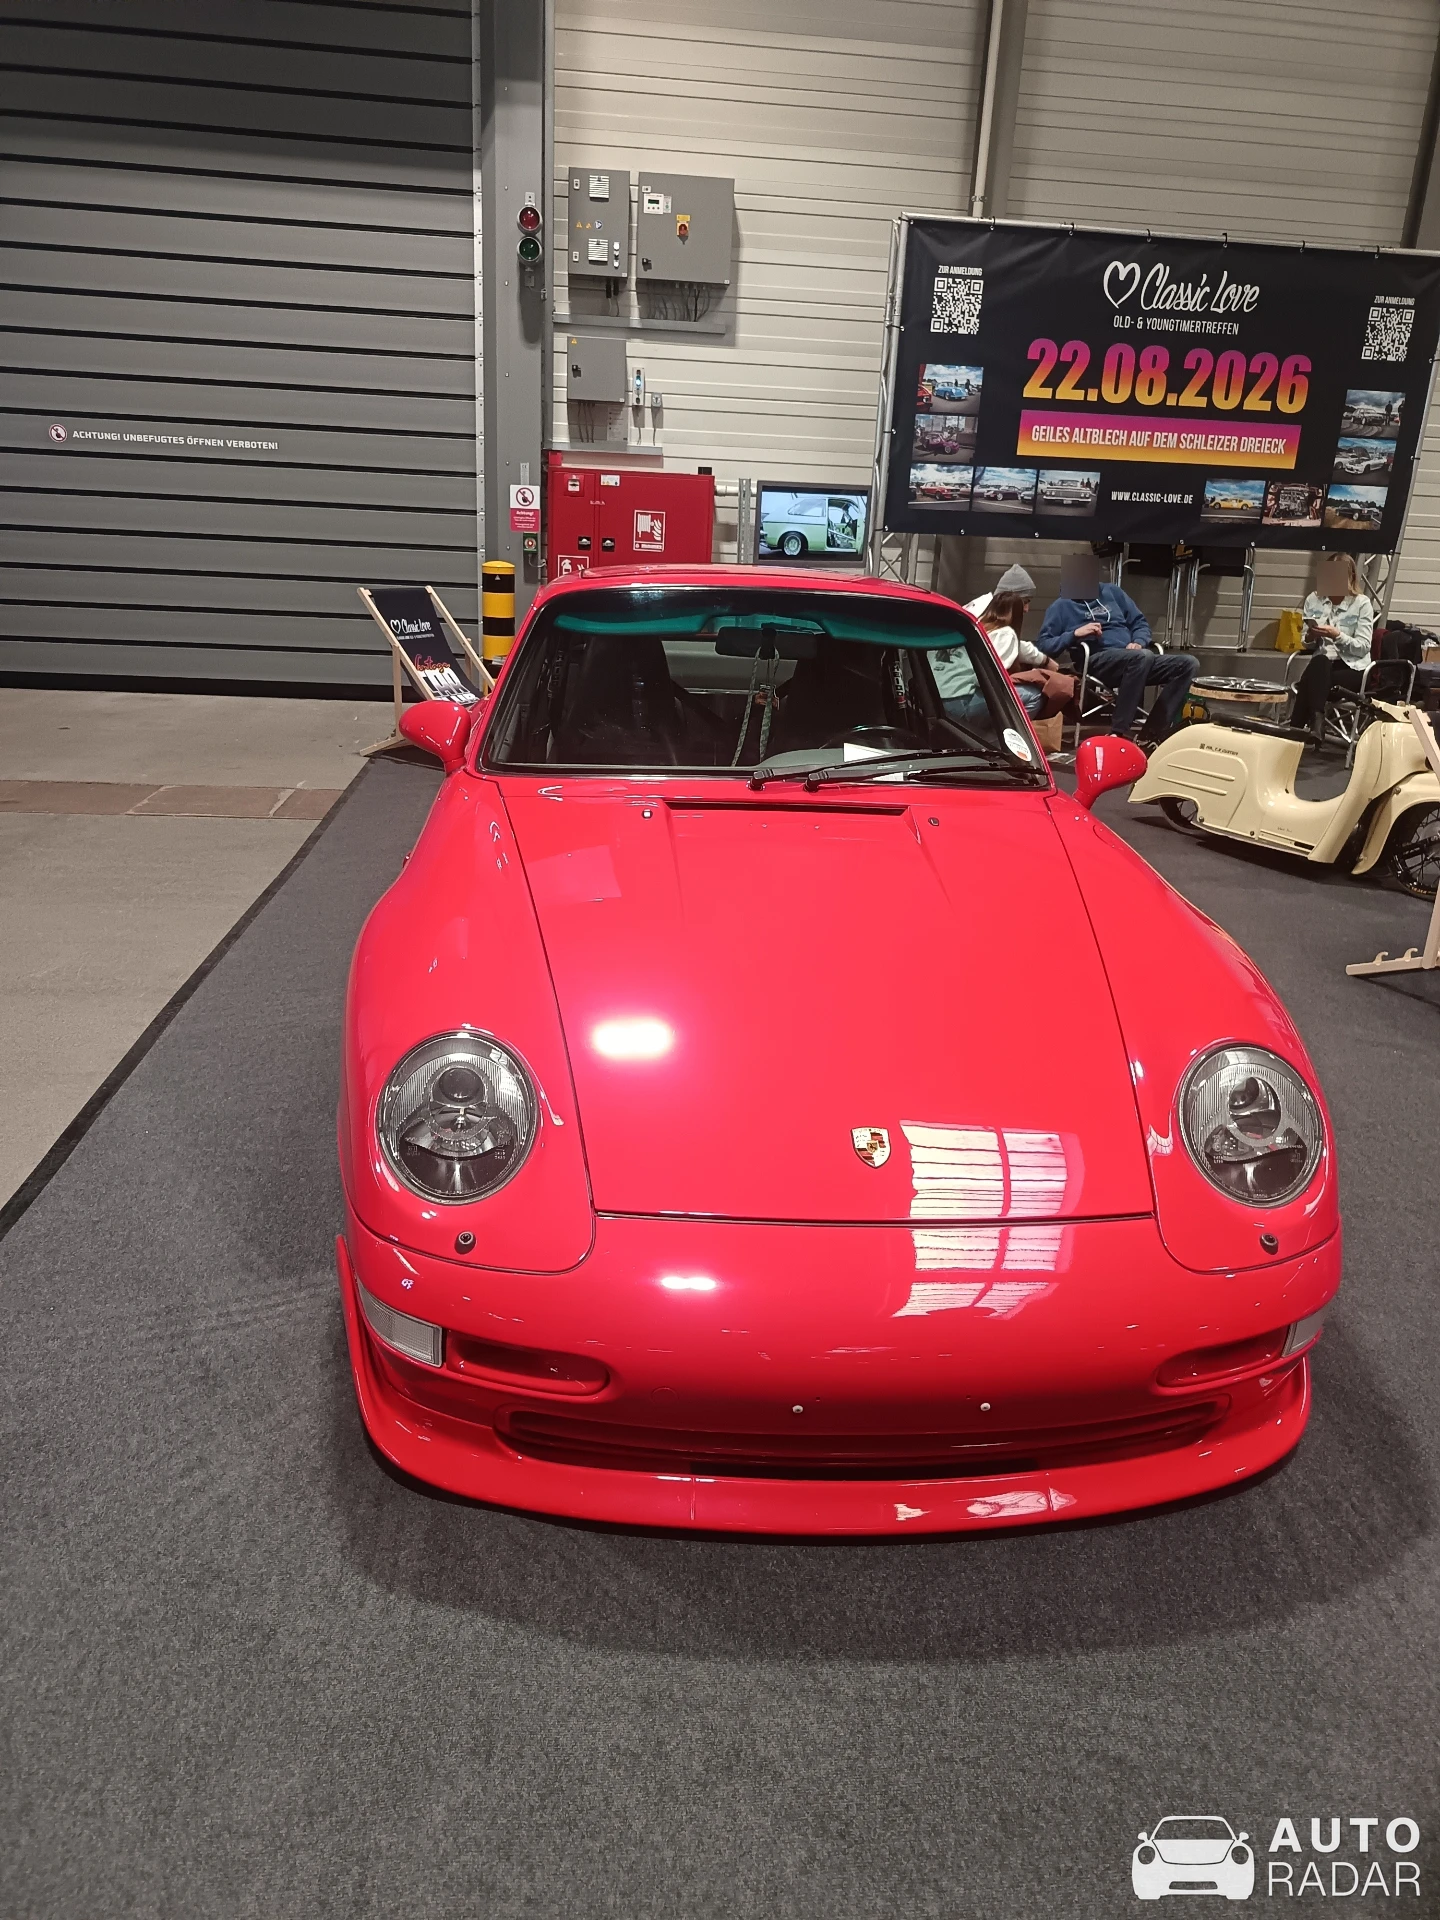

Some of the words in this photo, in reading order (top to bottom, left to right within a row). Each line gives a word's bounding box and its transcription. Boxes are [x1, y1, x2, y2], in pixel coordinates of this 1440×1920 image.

[938, 265, 949, 274] ZUR
[950, 266, 983, 276] ANMELDUNG
[1141, 262, 1211, 311] Classic
[1210, 270, 1260, 313] Love
[1374, 295, 1385, 304] ZUR
[1385, 296, 1415, 306] ANMELDUNG
[1113, 315, 1135, 329] OLD-
[1137, 317, 1144, 330] &
[1147, 317, 1240, 336] YOUNGTIMERTREFFEN
[1022, 337, 1312, 414] 22.08.2026
[72, 430, 121, 441] ACHTUNG!
[123, 433, 185, 445] UNBEFUGTES
[187, 435, 224, 447] ÖFFNEN
[226, 439, 279, 450] VERBOTEN!
[1031, 425, 1071, 444] GEILES
[1072, 427, 1128, 447] ALTBLECH
[1130, 430, 1152, 448] AUF
[1153, 431, 1177, 449] DEM
[1179, 433, 1239, 453] SCHLEIZER
[1240, 436, 1287, 455] DREIECK
[1111, 491, 1194, 505] WWW.CLASSIC-LOVE.DE
